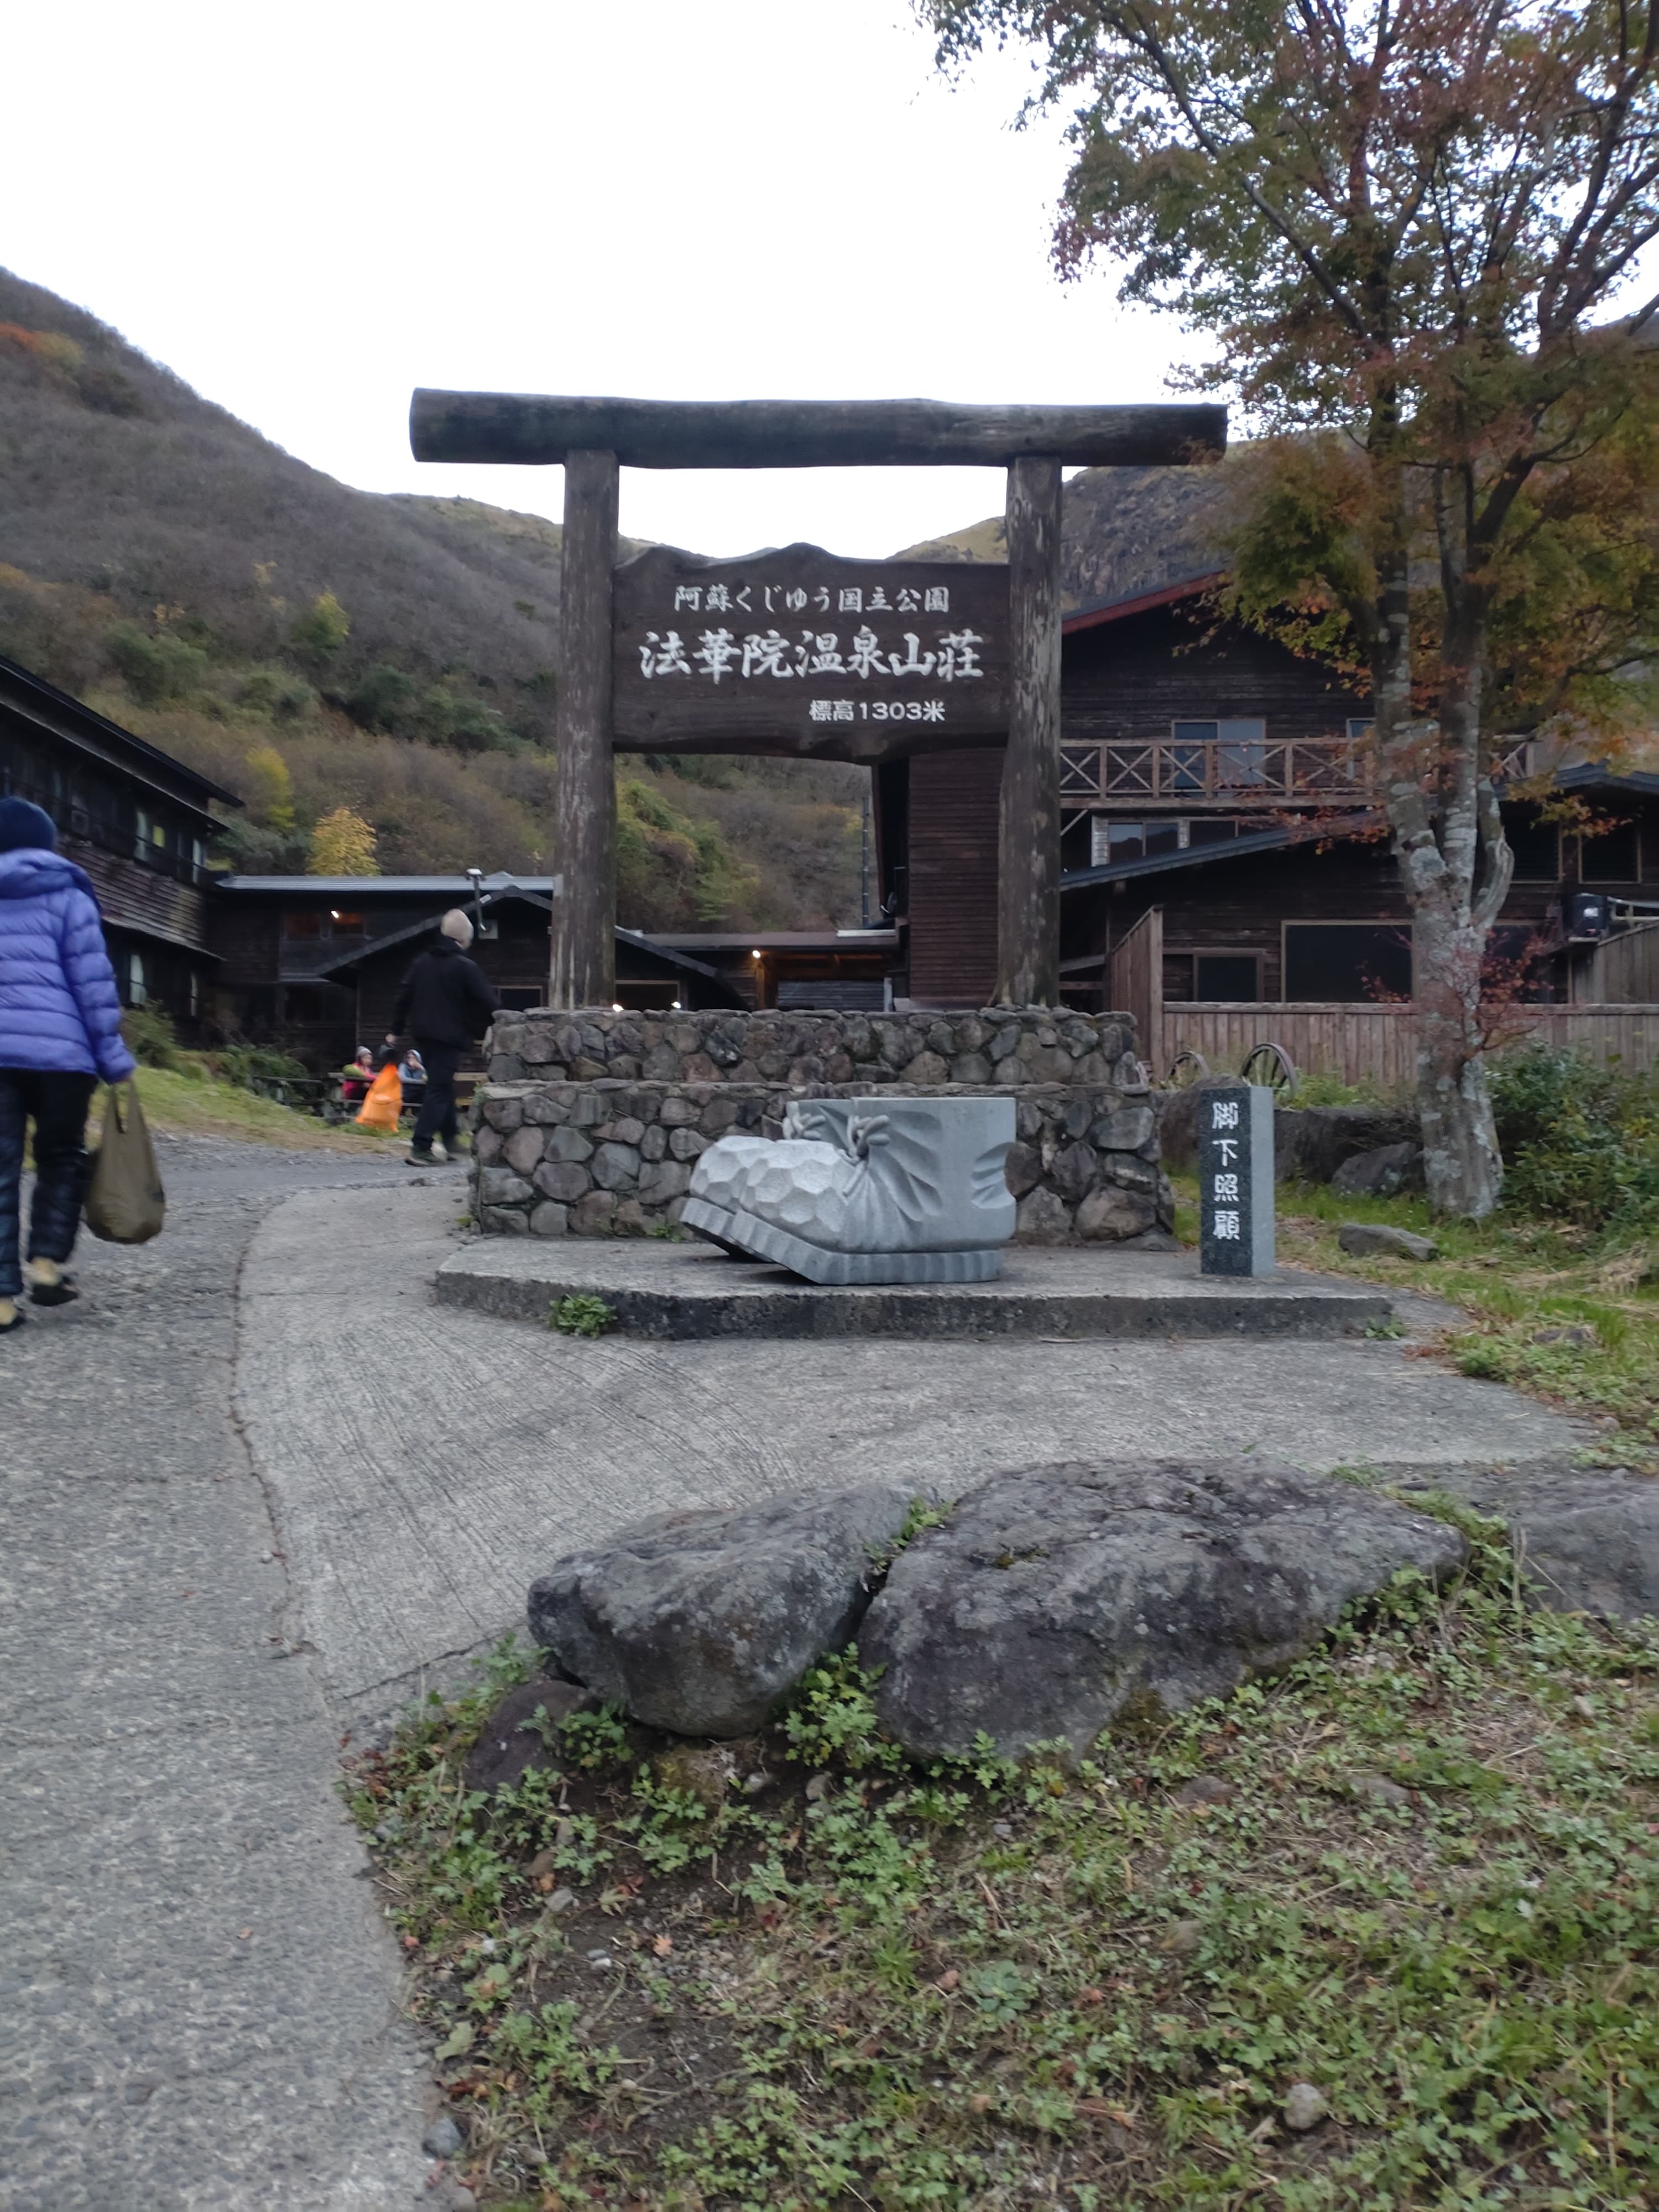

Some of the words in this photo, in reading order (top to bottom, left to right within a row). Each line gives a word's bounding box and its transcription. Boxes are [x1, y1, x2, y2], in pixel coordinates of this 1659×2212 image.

[638, 624, 984, 684] 法華院温泉山荘
[808, 699, 946, 723] 標高1303米
[1212, 1102, 1240, 1240] 脚下照顧
